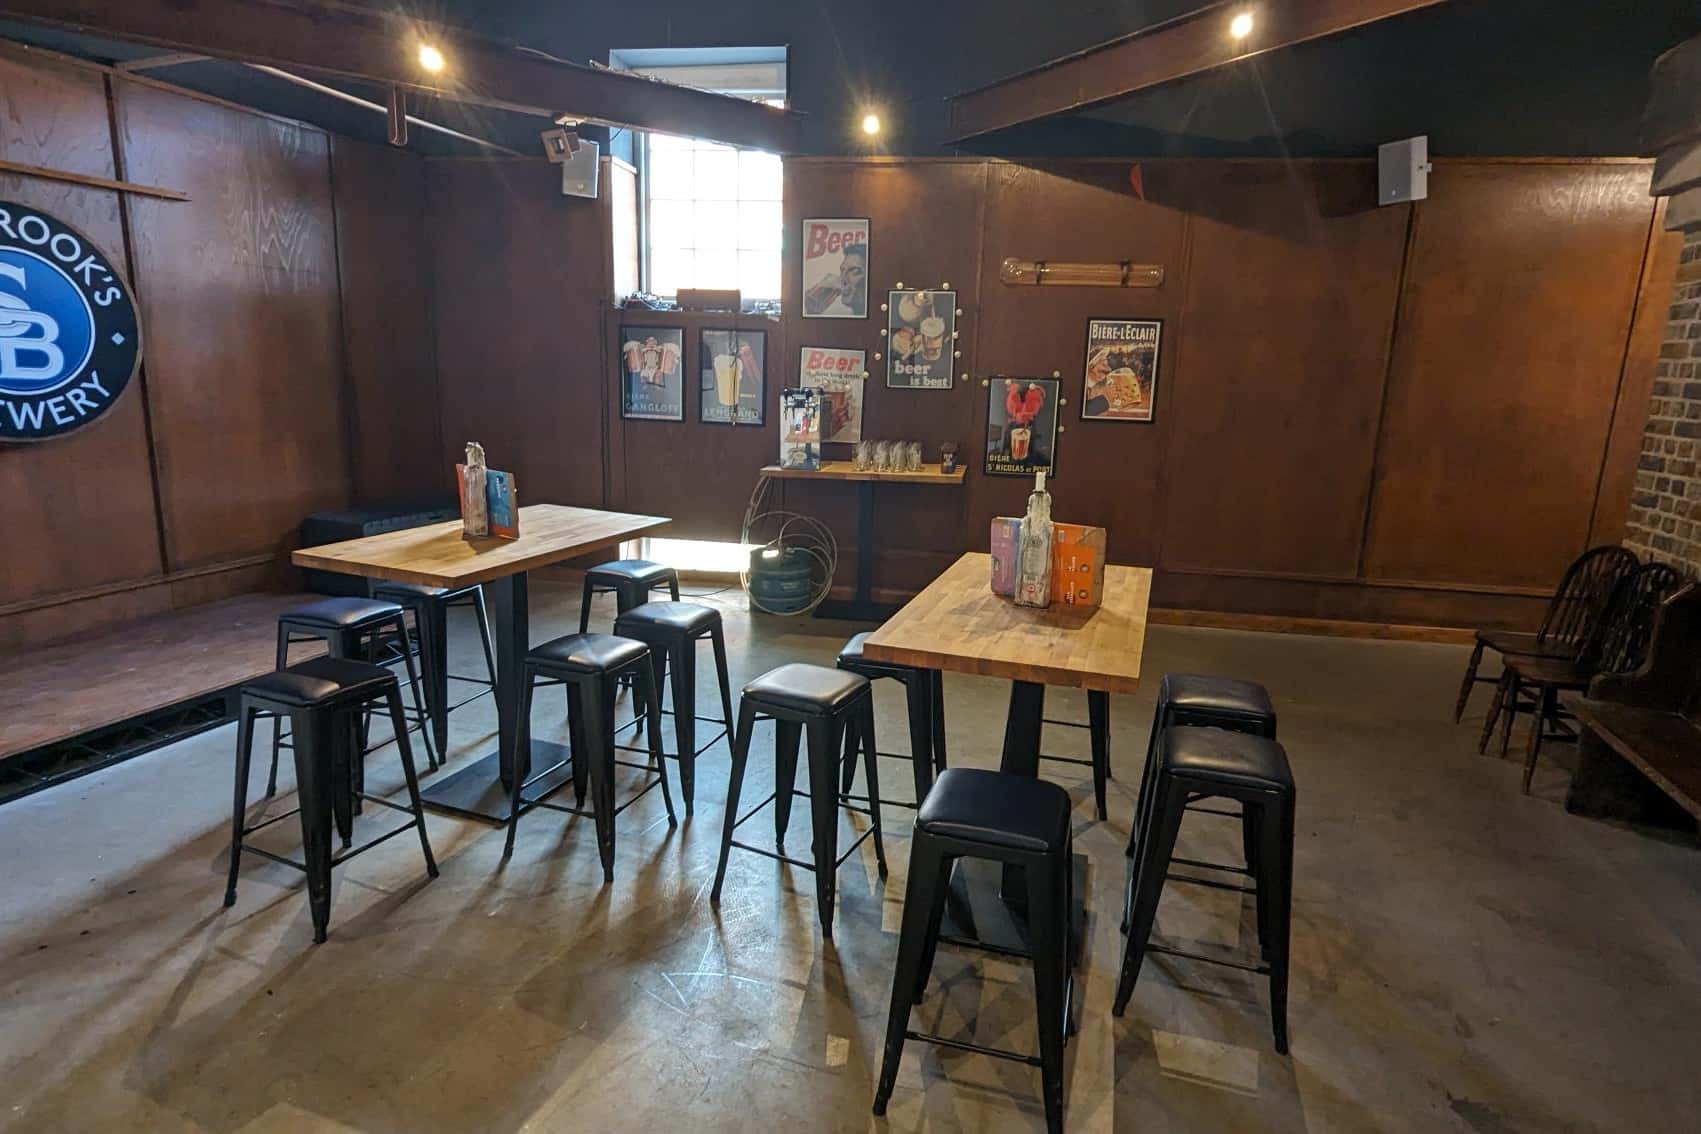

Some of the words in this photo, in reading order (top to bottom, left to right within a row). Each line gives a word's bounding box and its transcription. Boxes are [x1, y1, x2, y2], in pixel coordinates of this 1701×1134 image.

[806, 223, 866, 261] Beer
[806, 351, 861, 371] Beer
[894, 360, 931, 375] beer
[0, 370, 110, 430] WERY
